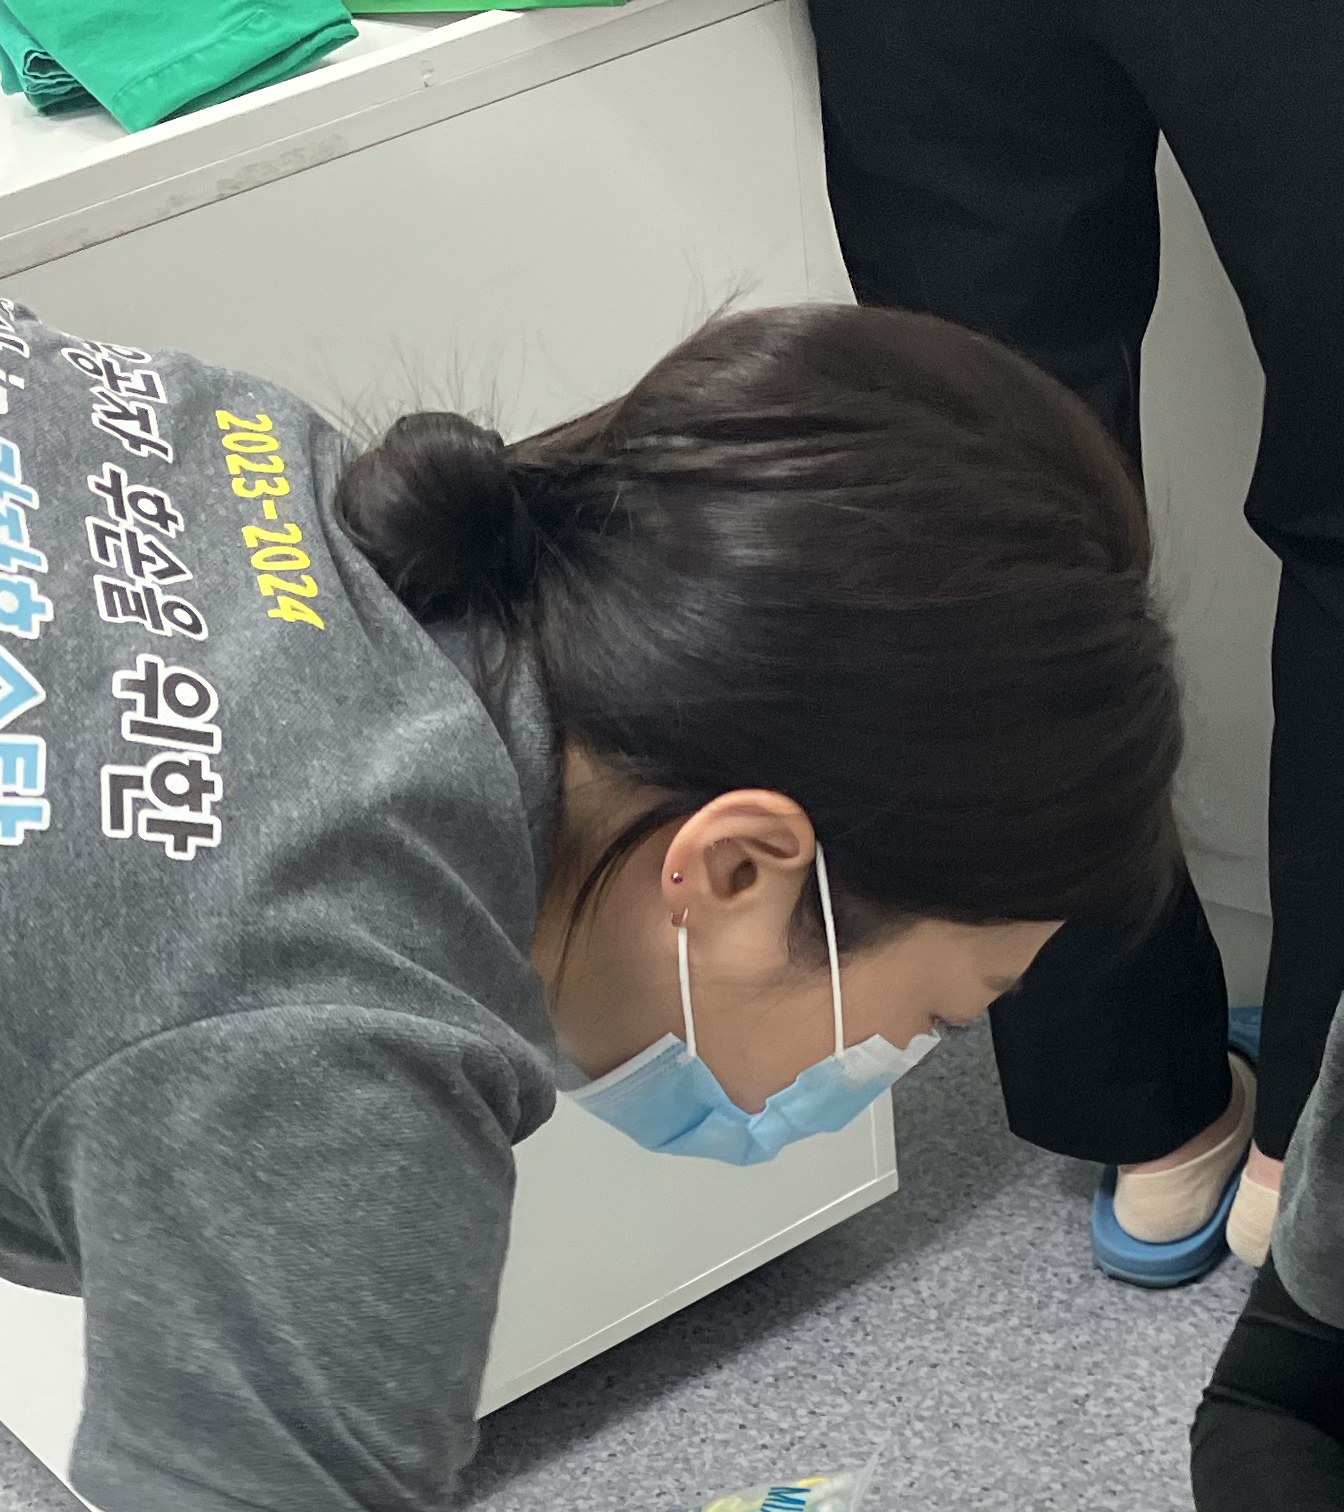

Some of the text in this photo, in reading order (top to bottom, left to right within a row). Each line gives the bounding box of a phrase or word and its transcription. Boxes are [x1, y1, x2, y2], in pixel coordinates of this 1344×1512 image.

[87, 462, 208, 641] 후손을
[215, 409, 325, 631] 2023-2024
[100, 653, 223, 861] 위한
